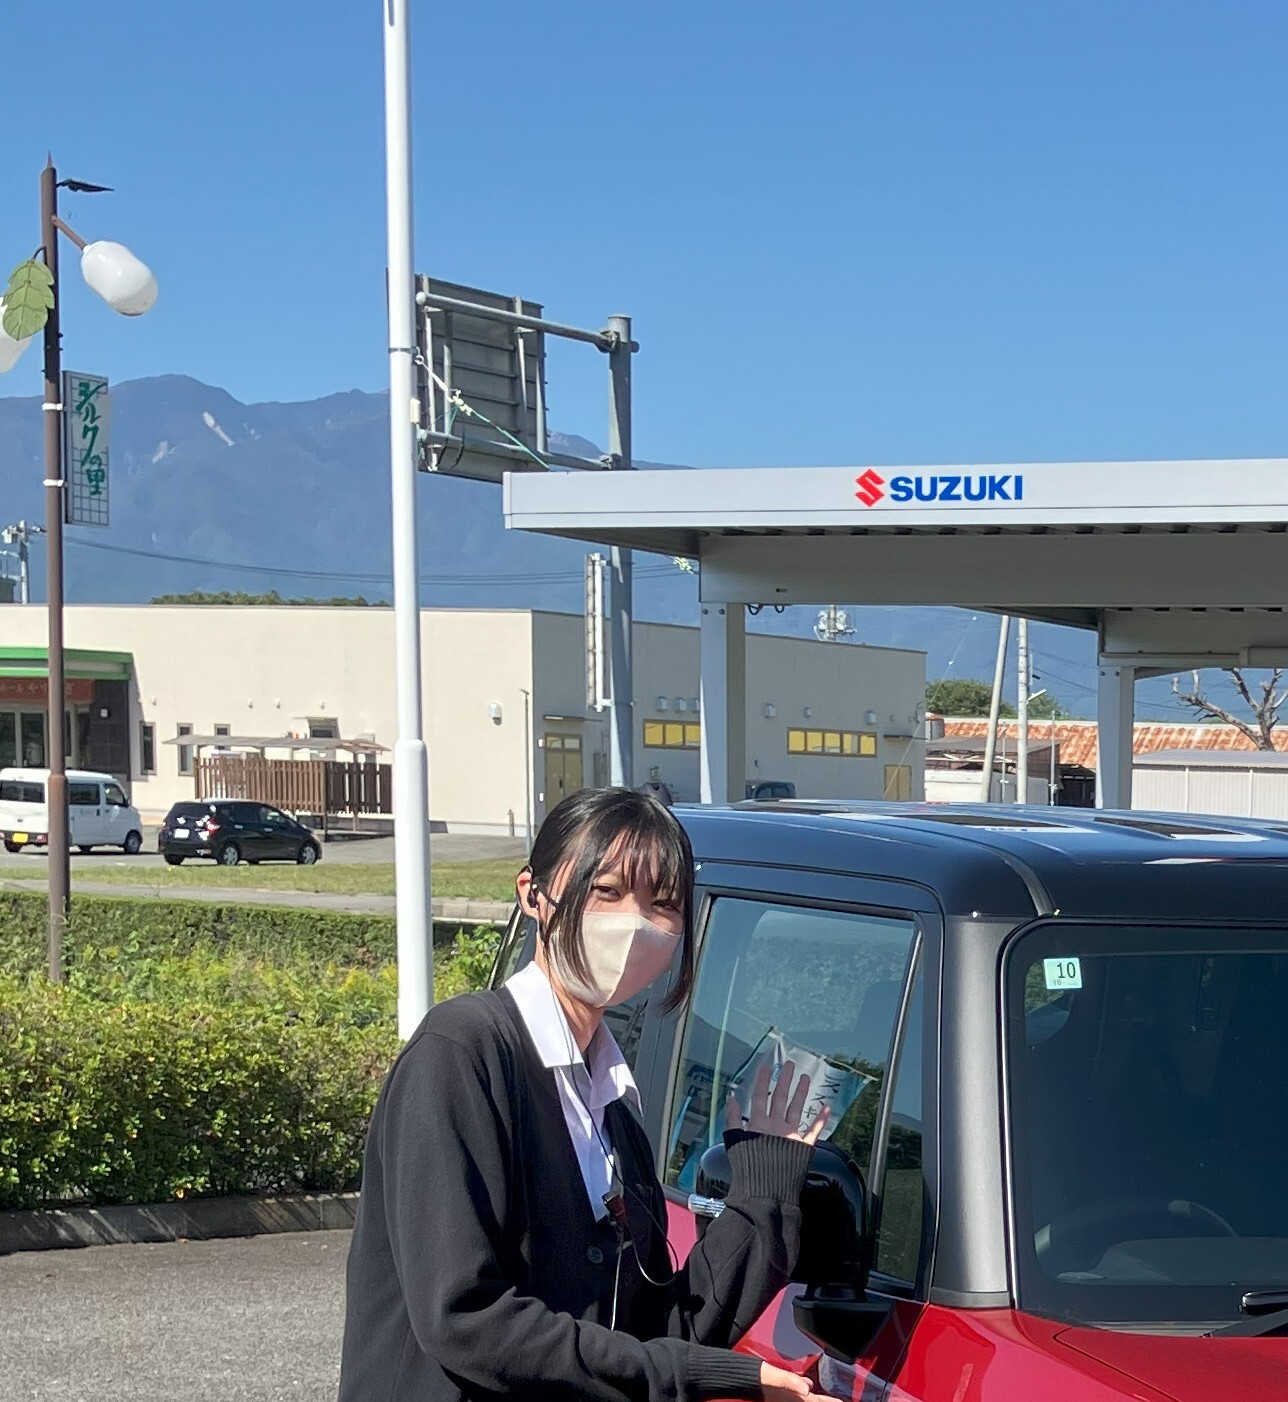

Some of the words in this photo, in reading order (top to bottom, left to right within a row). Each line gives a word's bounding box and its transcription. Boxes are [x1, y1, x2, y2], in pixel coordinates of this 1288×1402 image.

[75, 381, 108, 496] シルクの里
[889, 475, 1023, 502] SUZUKI
[1056, 961, 1076, 979] 10
